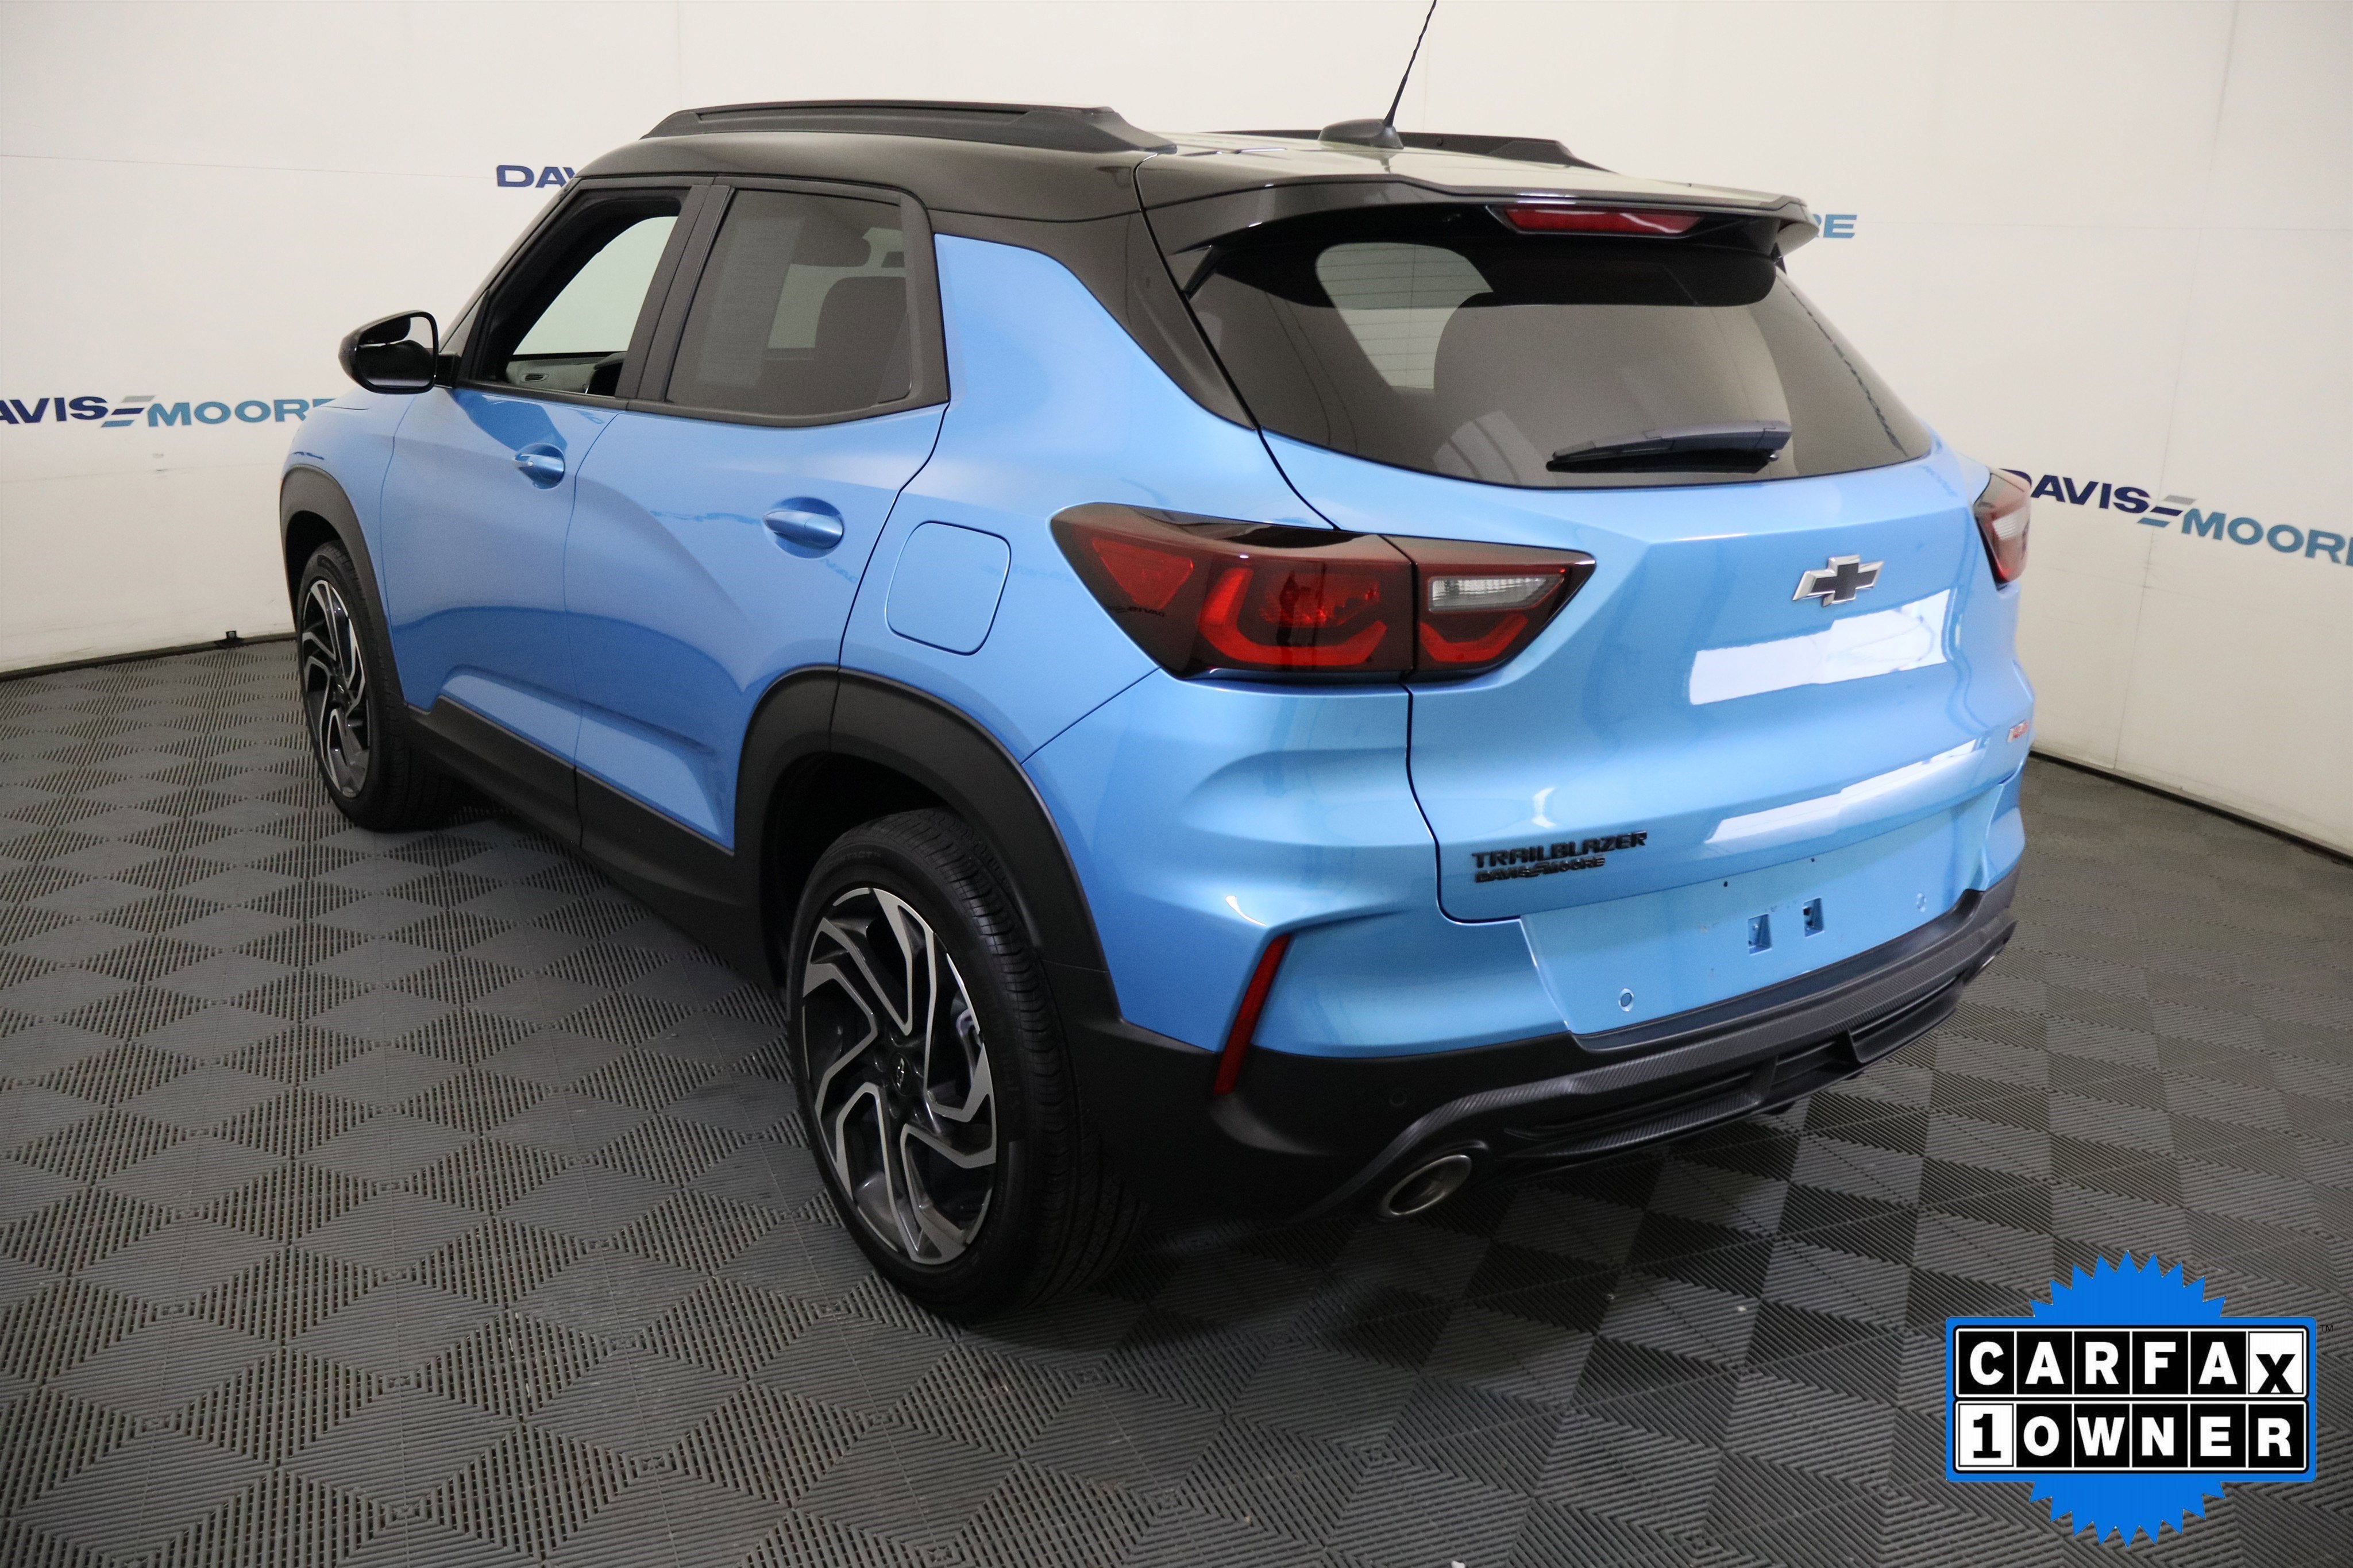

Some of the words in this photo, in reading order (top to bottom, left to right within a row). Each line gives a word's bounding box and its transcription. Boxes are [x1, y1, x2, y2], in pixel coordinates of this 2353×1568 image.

[0, 396, 109, 424] AVIS
[2181, 508, 2353, 567] MOOR
[1472, 831, 1647, 868] TRAILBLAZER
